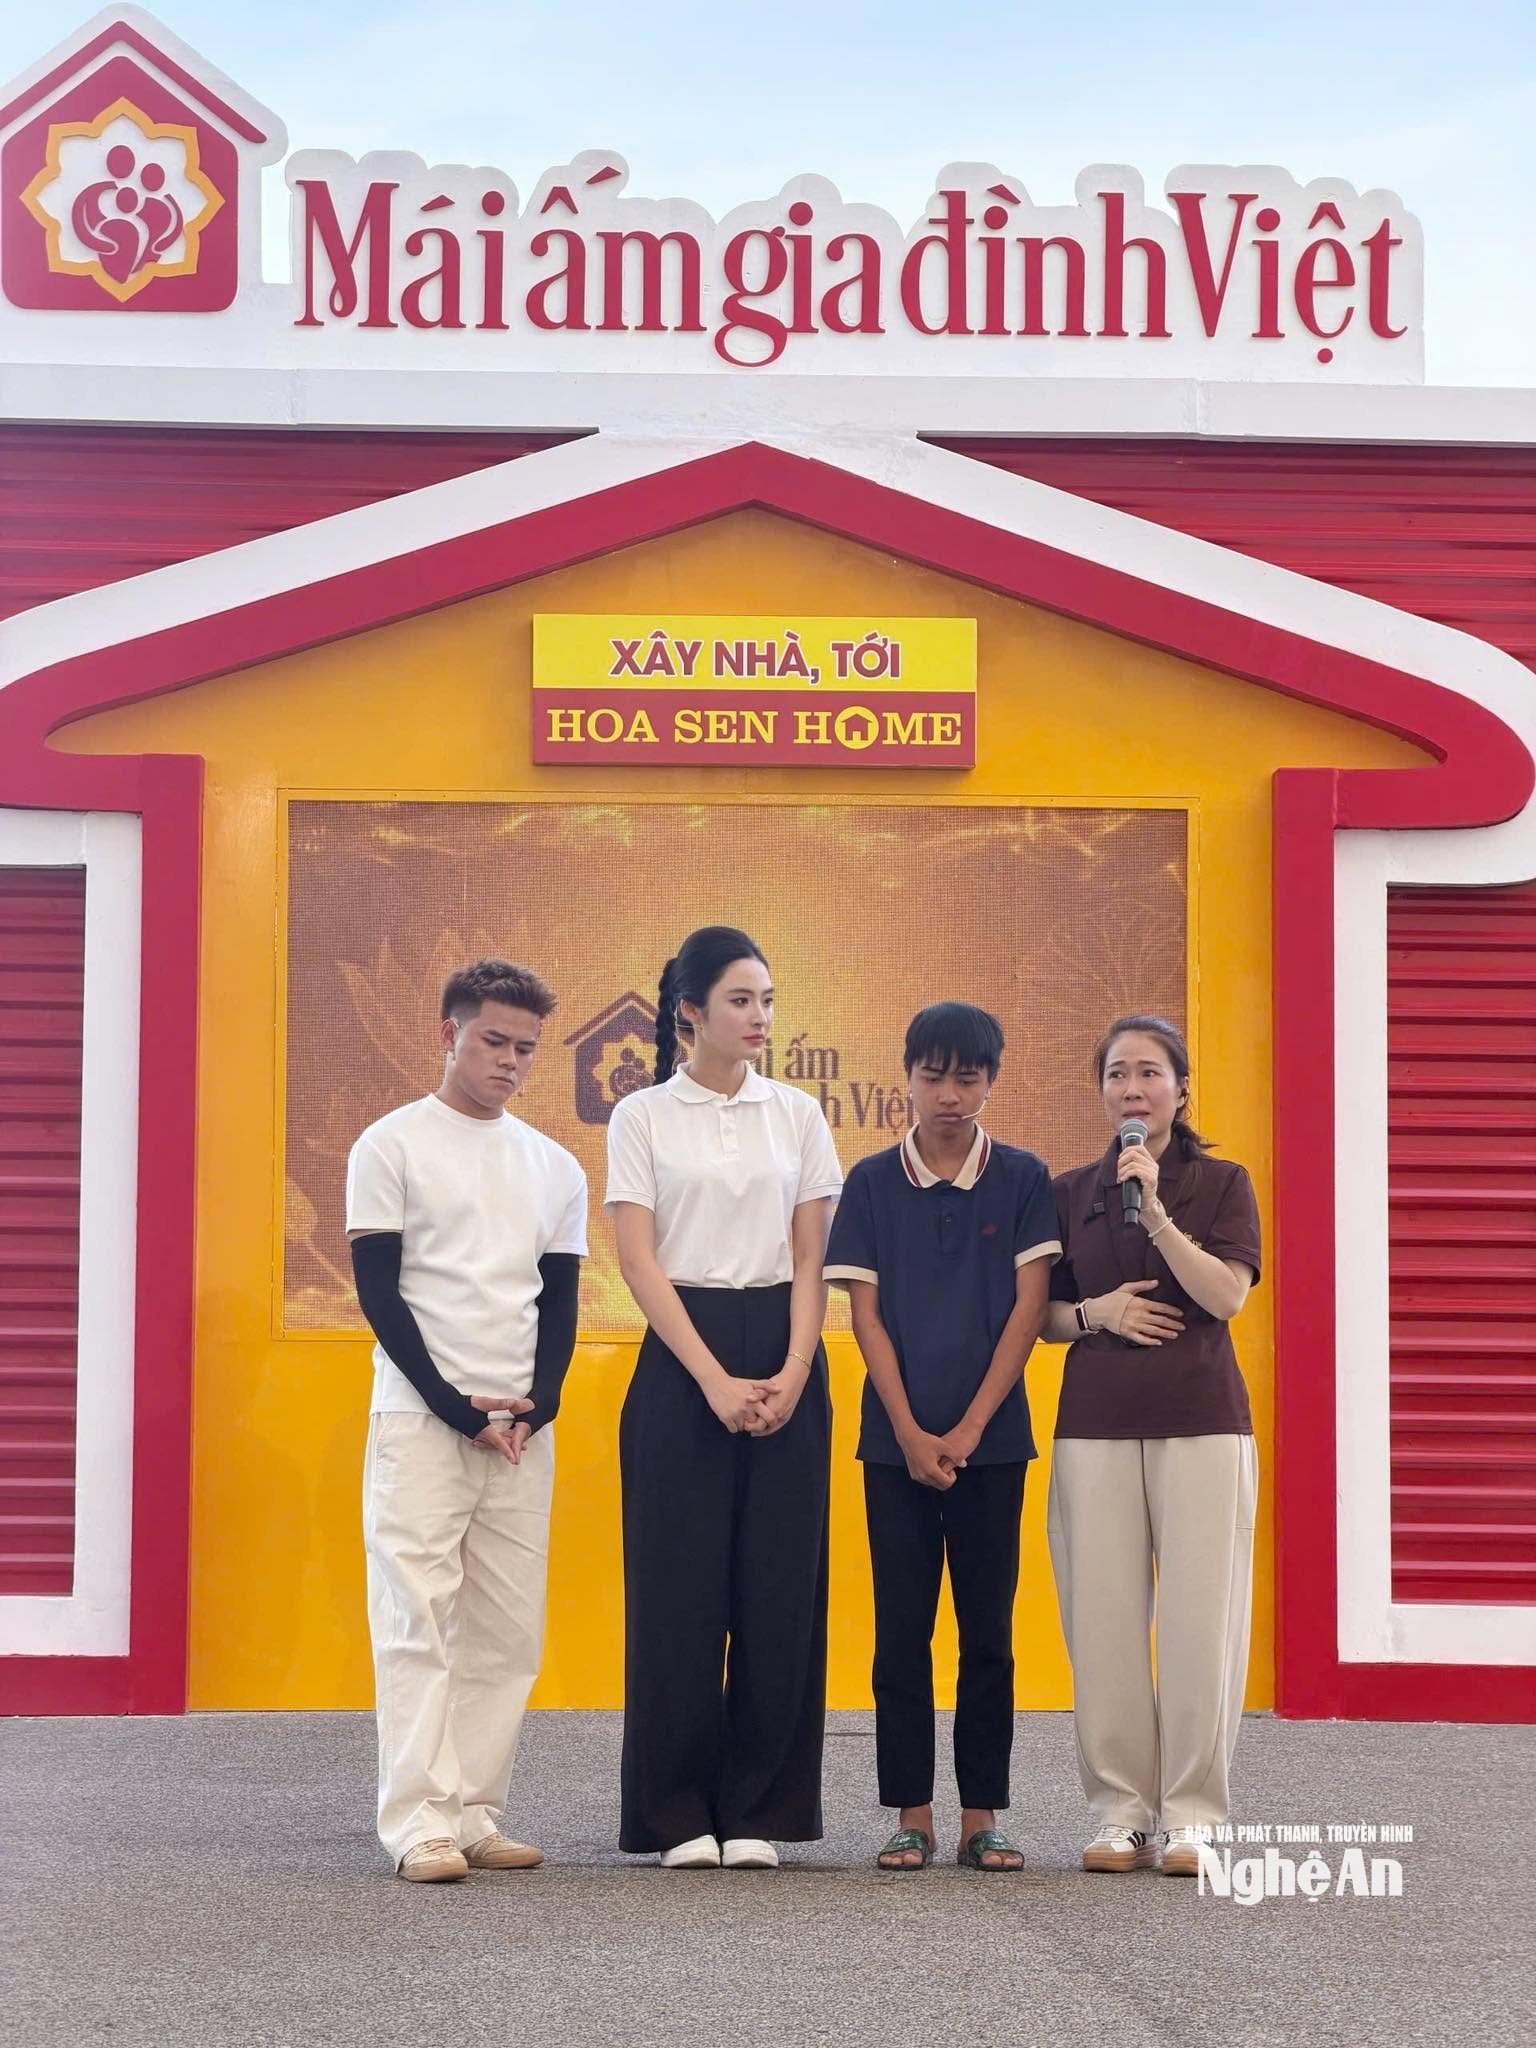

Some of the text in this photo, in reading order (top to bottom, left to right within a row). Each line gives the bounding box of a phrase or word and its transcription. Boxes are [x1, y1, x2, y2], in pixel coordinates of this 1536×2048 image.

[294, 166, 1408, 368] Mái ấm gia đình Việt
[609, 629, 902, 686] XÂY NHÀ, TỚI
[547, 709, 660, 743] HOA
[674, 710, 778, 744] SEN
[784, 1033, 839, 1080] ấm
